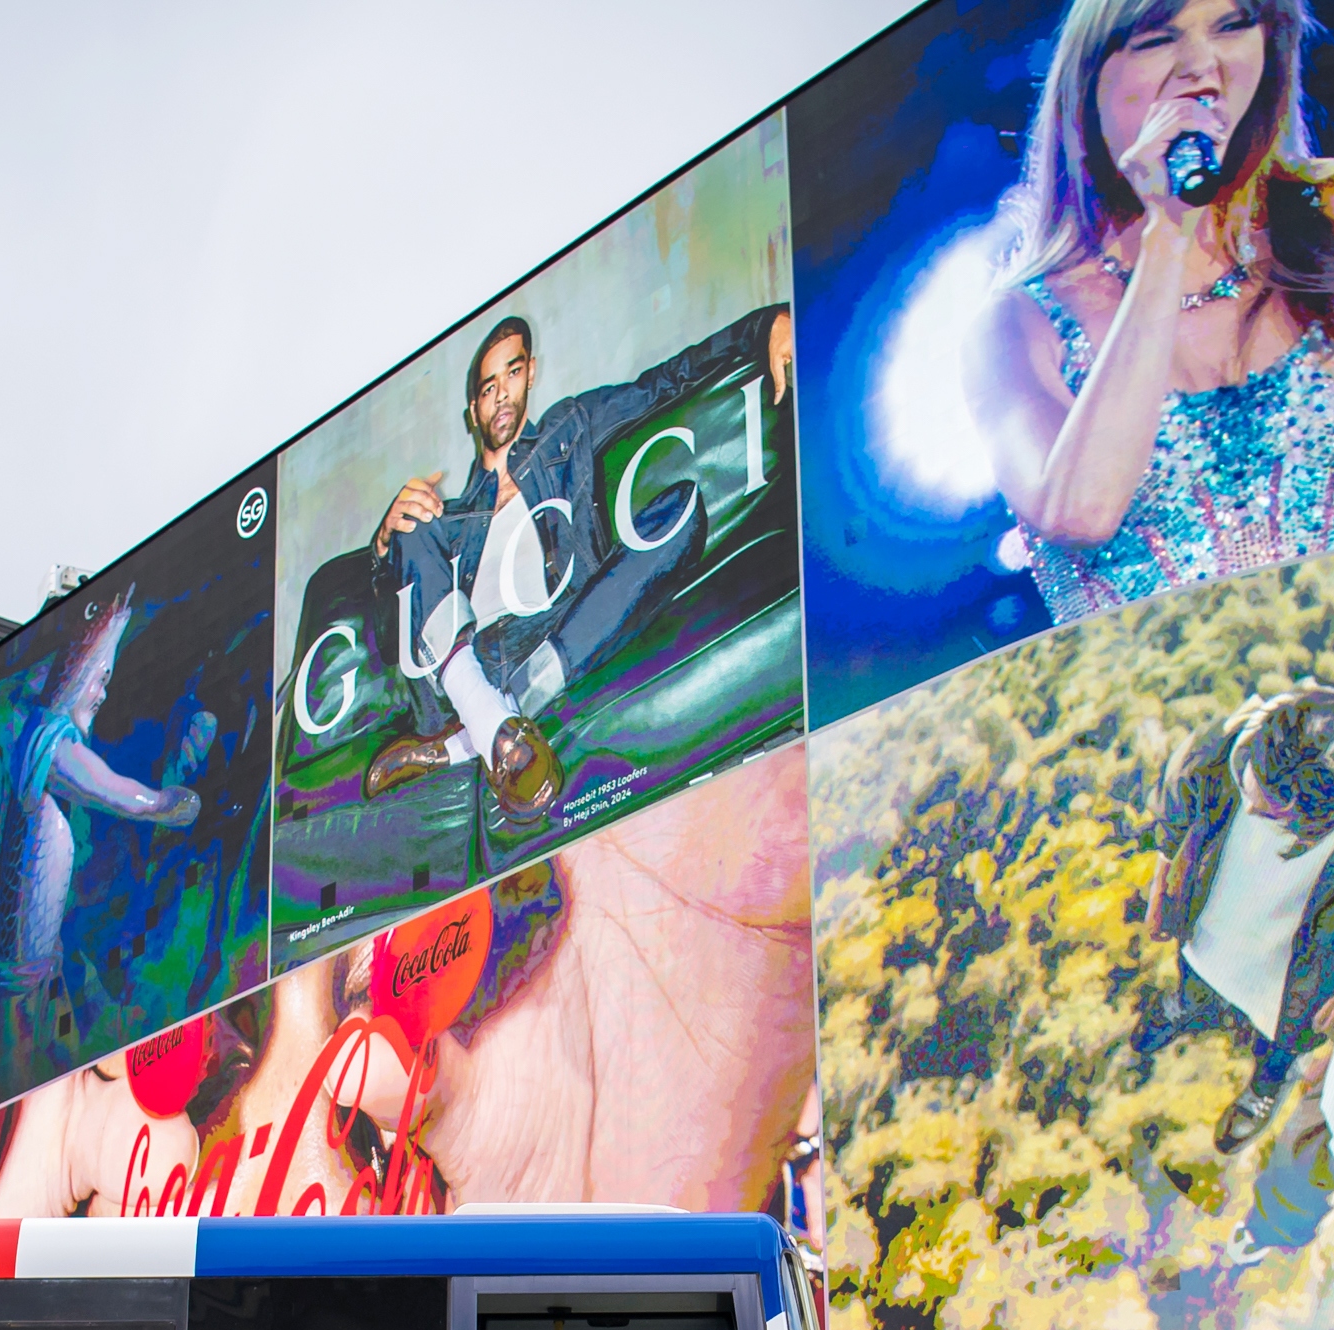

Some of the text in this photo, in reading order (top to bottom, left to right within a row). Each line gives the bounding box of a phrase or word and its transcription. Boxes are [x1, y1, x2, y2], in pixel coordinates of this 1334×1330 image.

[241, 498, 264, 527] SG
[293, 374, 769, 736] GUCCI
[563, 766, 648, 813] Horsebit 1953 Loafers
[563, 816, 573, 828] By
[574, 806, 590, 822] Heji
[610, 787, 633, 806] 2024
[289, 905, 356, 943] Kingsley Ben-Adir
[132, 1025, 184, 1077] CocaCola
